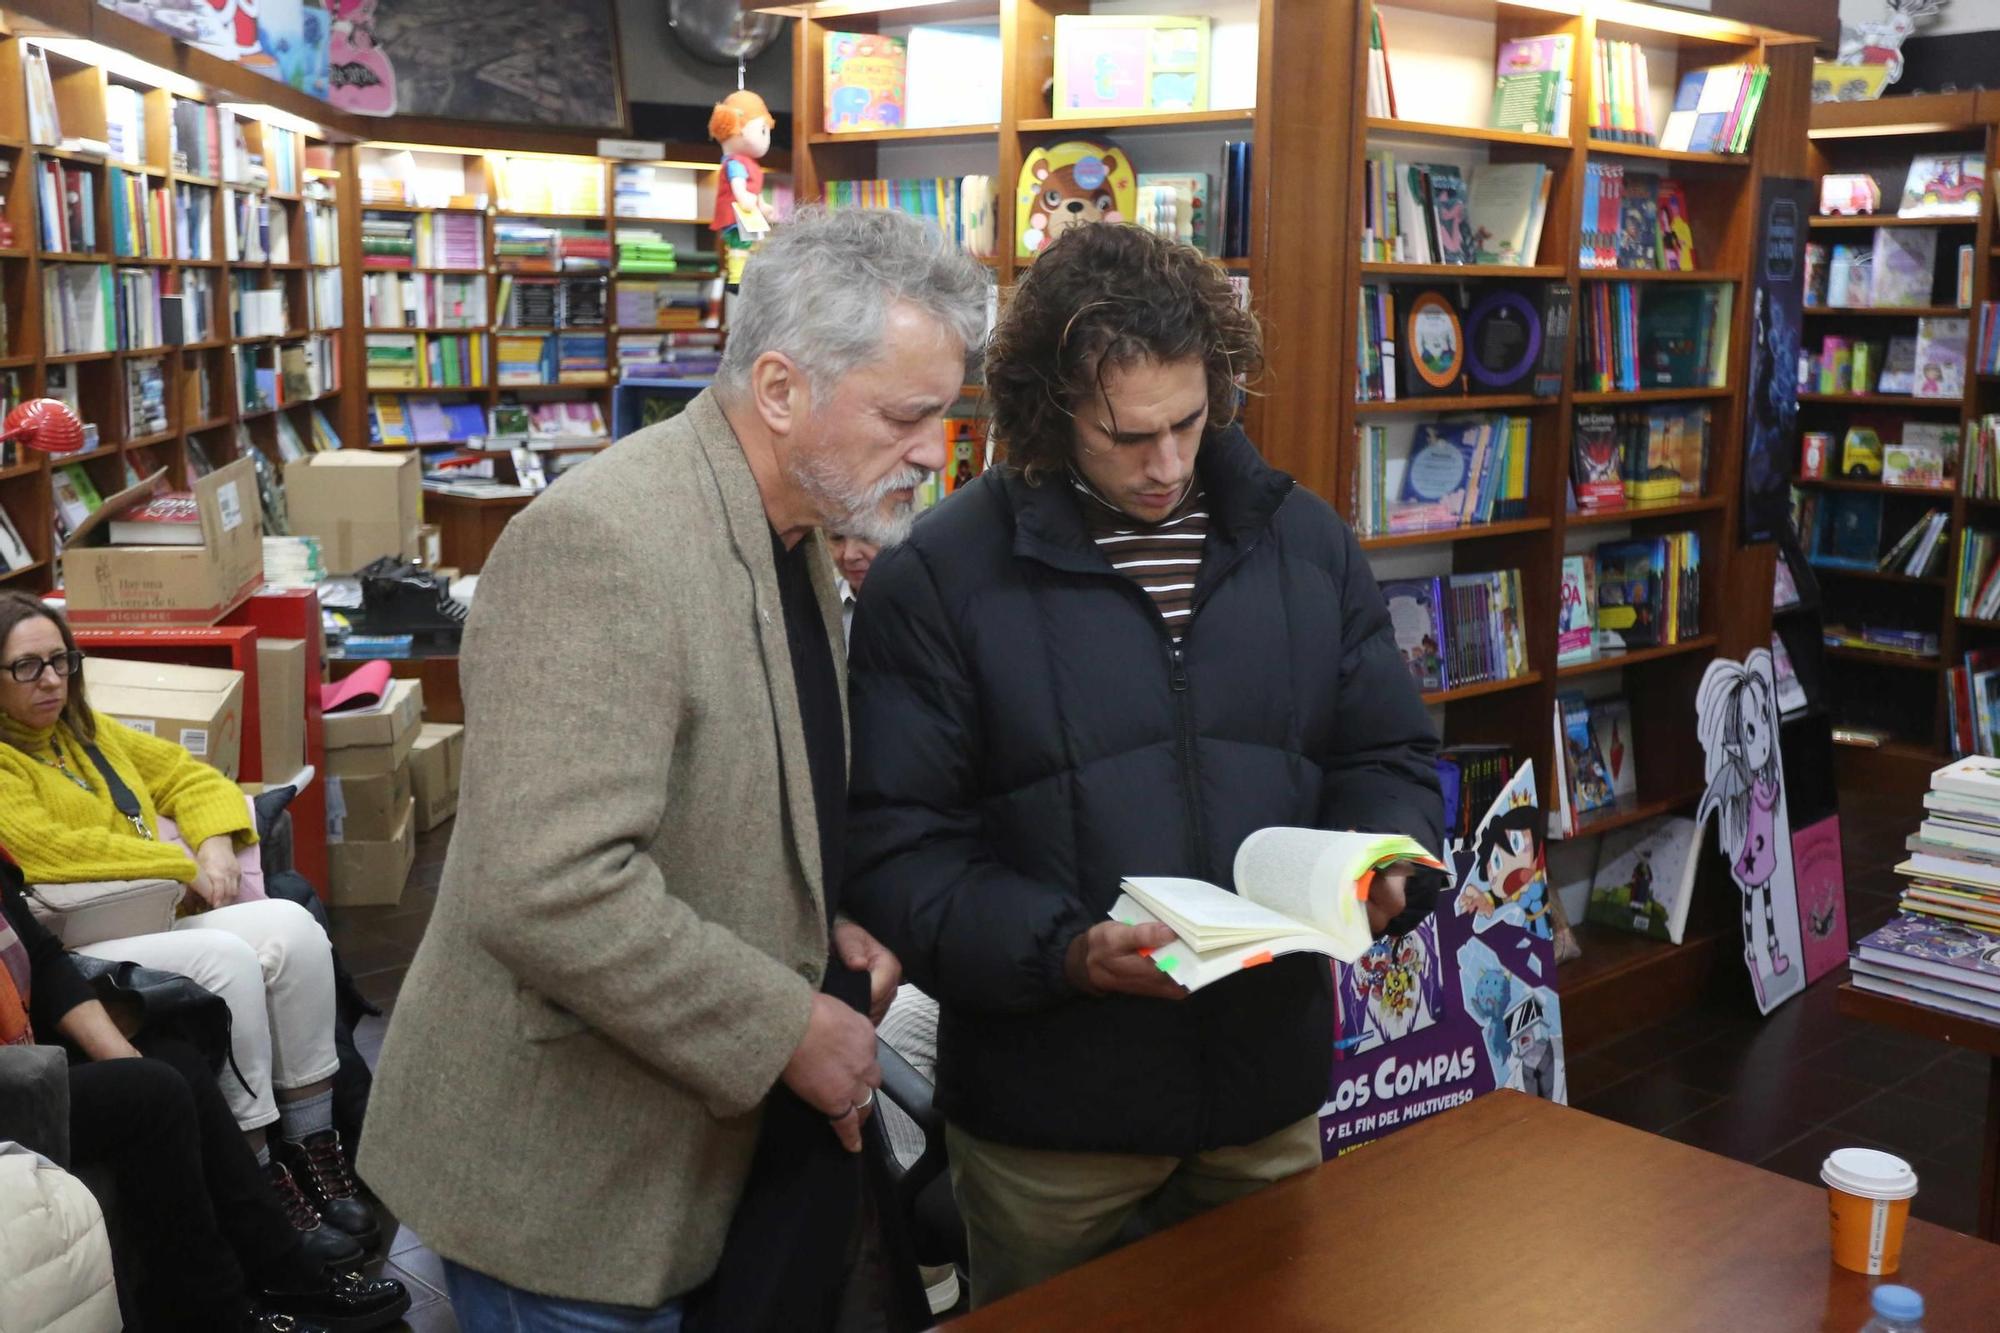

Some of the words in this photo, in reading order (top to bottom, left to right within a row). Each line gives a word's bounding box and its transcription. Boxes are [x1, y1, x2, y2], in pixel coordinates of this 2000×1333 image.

[1374, 1046, 1476, 1100] COMPAS
[1326, 1126, 1337, 1142] Y
[1338, 1123, 1352, 1139] EL
[1355, 1115, 1376, 1135] FIN
[1378, 1110, 1401, 1127] DEL
[1402, 1088, 1474, 1120] MULTIVERSO
